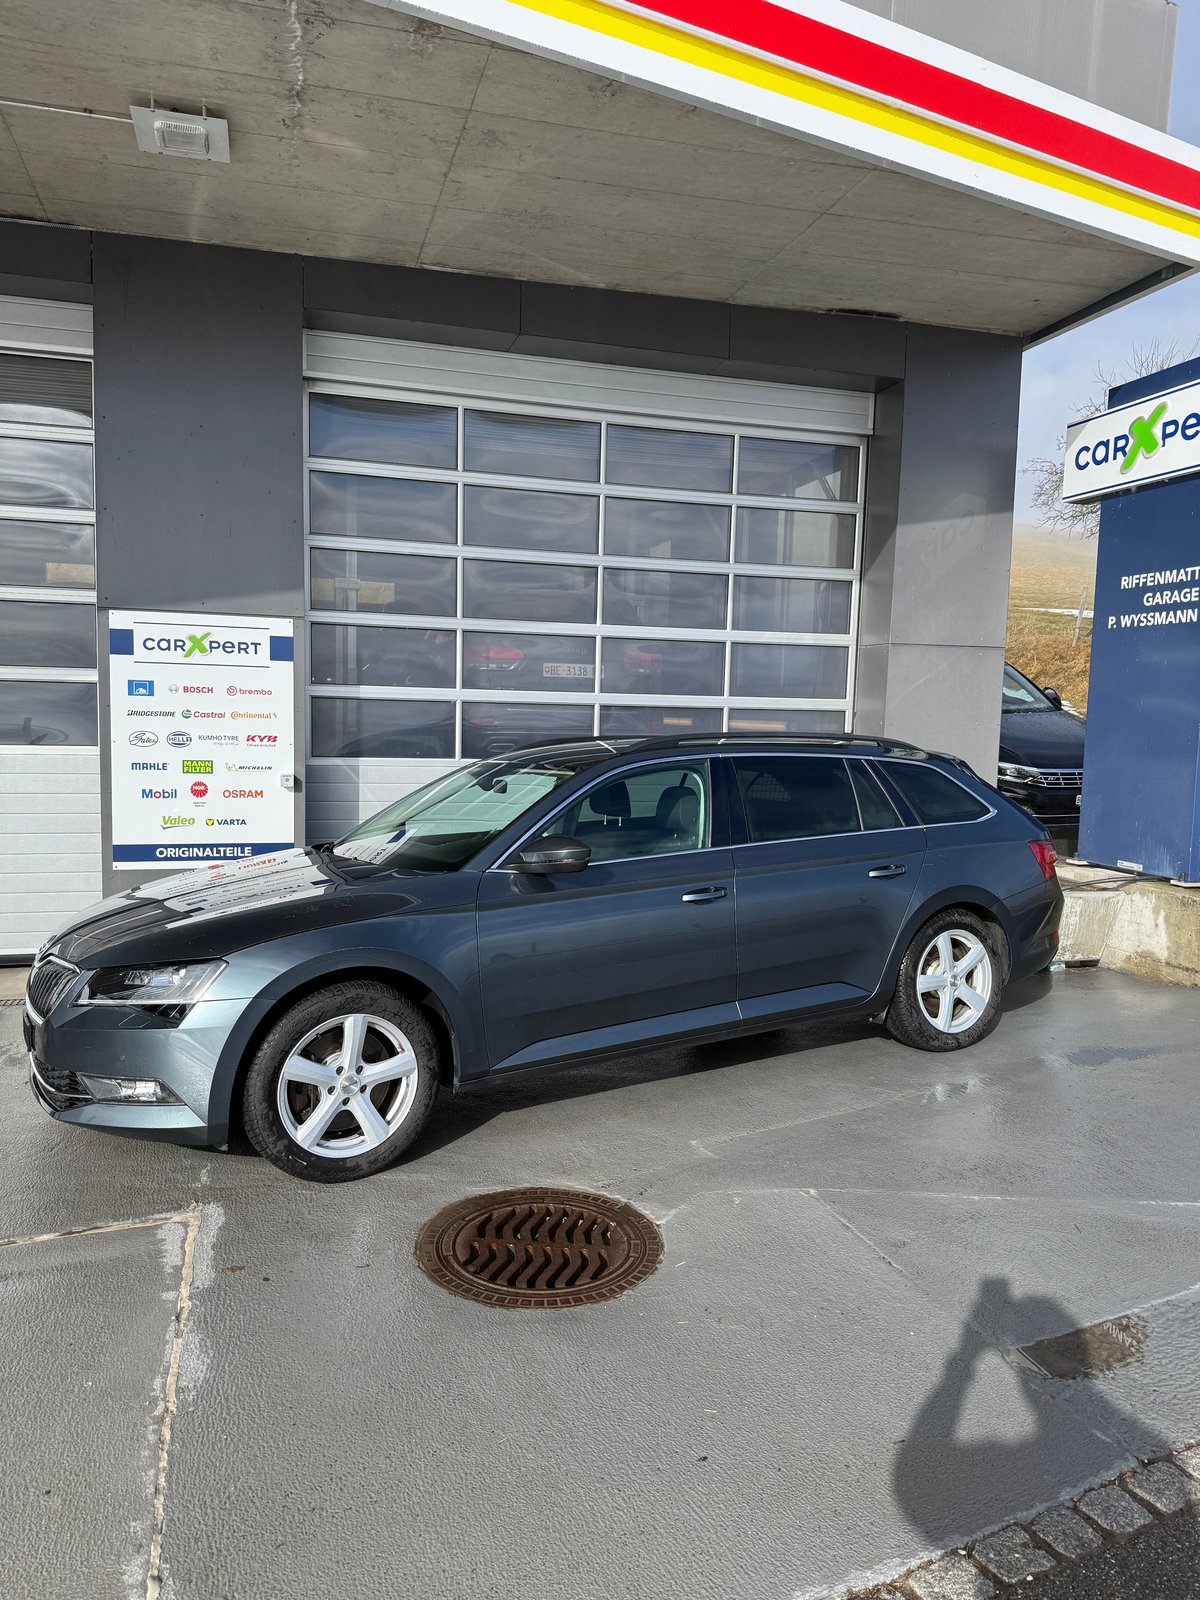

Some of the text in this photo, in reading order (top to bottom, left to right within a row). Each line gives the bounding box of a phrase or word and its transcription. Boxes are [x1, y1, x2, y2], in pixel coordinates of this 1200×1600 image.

[1143, 587, 1200, 607] GARAGE
[1107, 608, 1198, 629] P. WYSSMANN
[183, 685, 214, 694] BOSCH
[239, 687, 273, 696] brembo
[127, 709, 176, 717] BRIDGESTONE
[193, 711, 226, 719] Castrol
[231, 710, 272, 720] Continental
[198, 734, 222, 742] KUMHO
[131, 762, 168, 771] MAHLE
[141, 788, 177, 799] Mobil
[223, 789, 264, 799] OSRAM
[162, 815, 195, 826] Valeo
[217, 818, 247, 826] VARTA
[155, 846, 252, 858] ORIGINALTEILE
